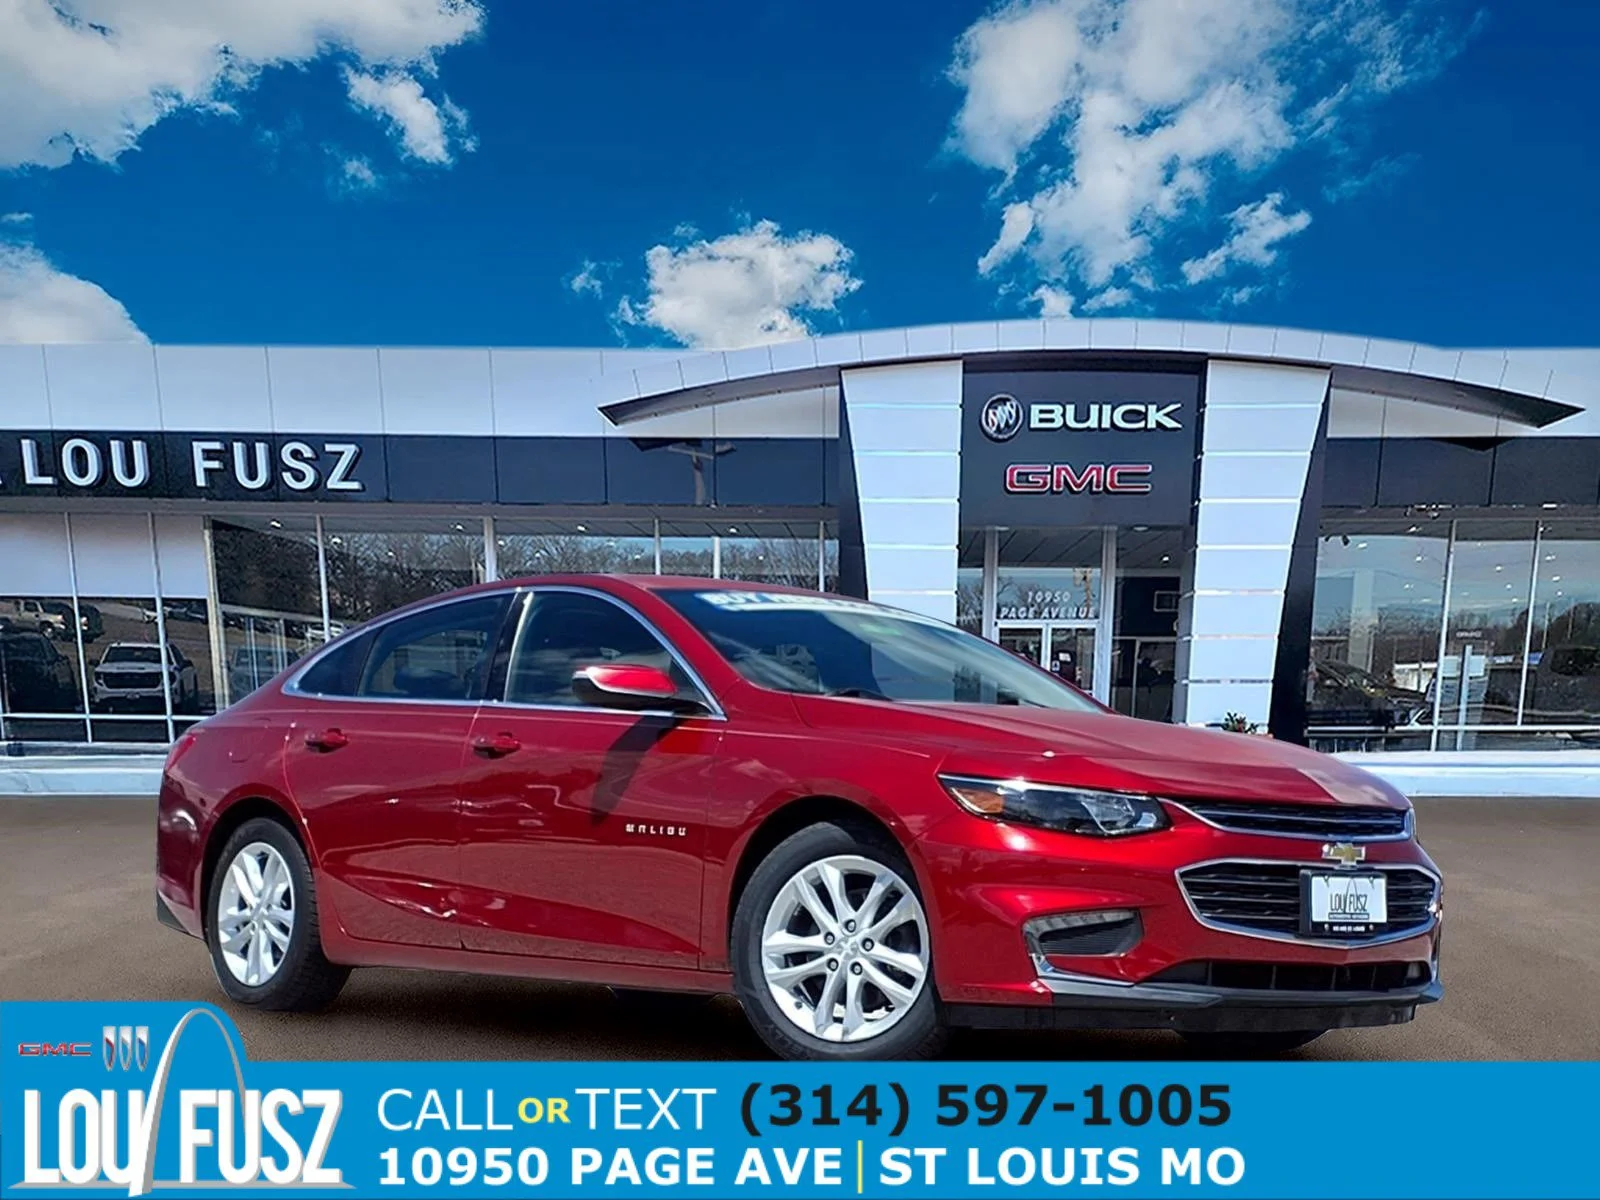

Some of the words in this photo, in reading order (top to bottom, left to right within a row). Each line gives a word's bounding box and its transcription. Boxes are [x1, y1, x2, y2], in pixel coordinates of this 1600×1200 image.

[1030, 403, 1182, 430] BUICK
[21, 438, 149, 487] LOU
[192, 441, 363, 491] FUSZ
[1006, 463, 1152, 493] GMC
[1027, 591, 1071, 603] 10950
[1000, 606, 1034, 619] PAGE
[1041, 606, 1095, 619] AVENUE
[625, 823, 687, 837] MALIBU
[1330, 893, 1346, 912] LOU
[1349, 893, 1368, 912] FUSZ
